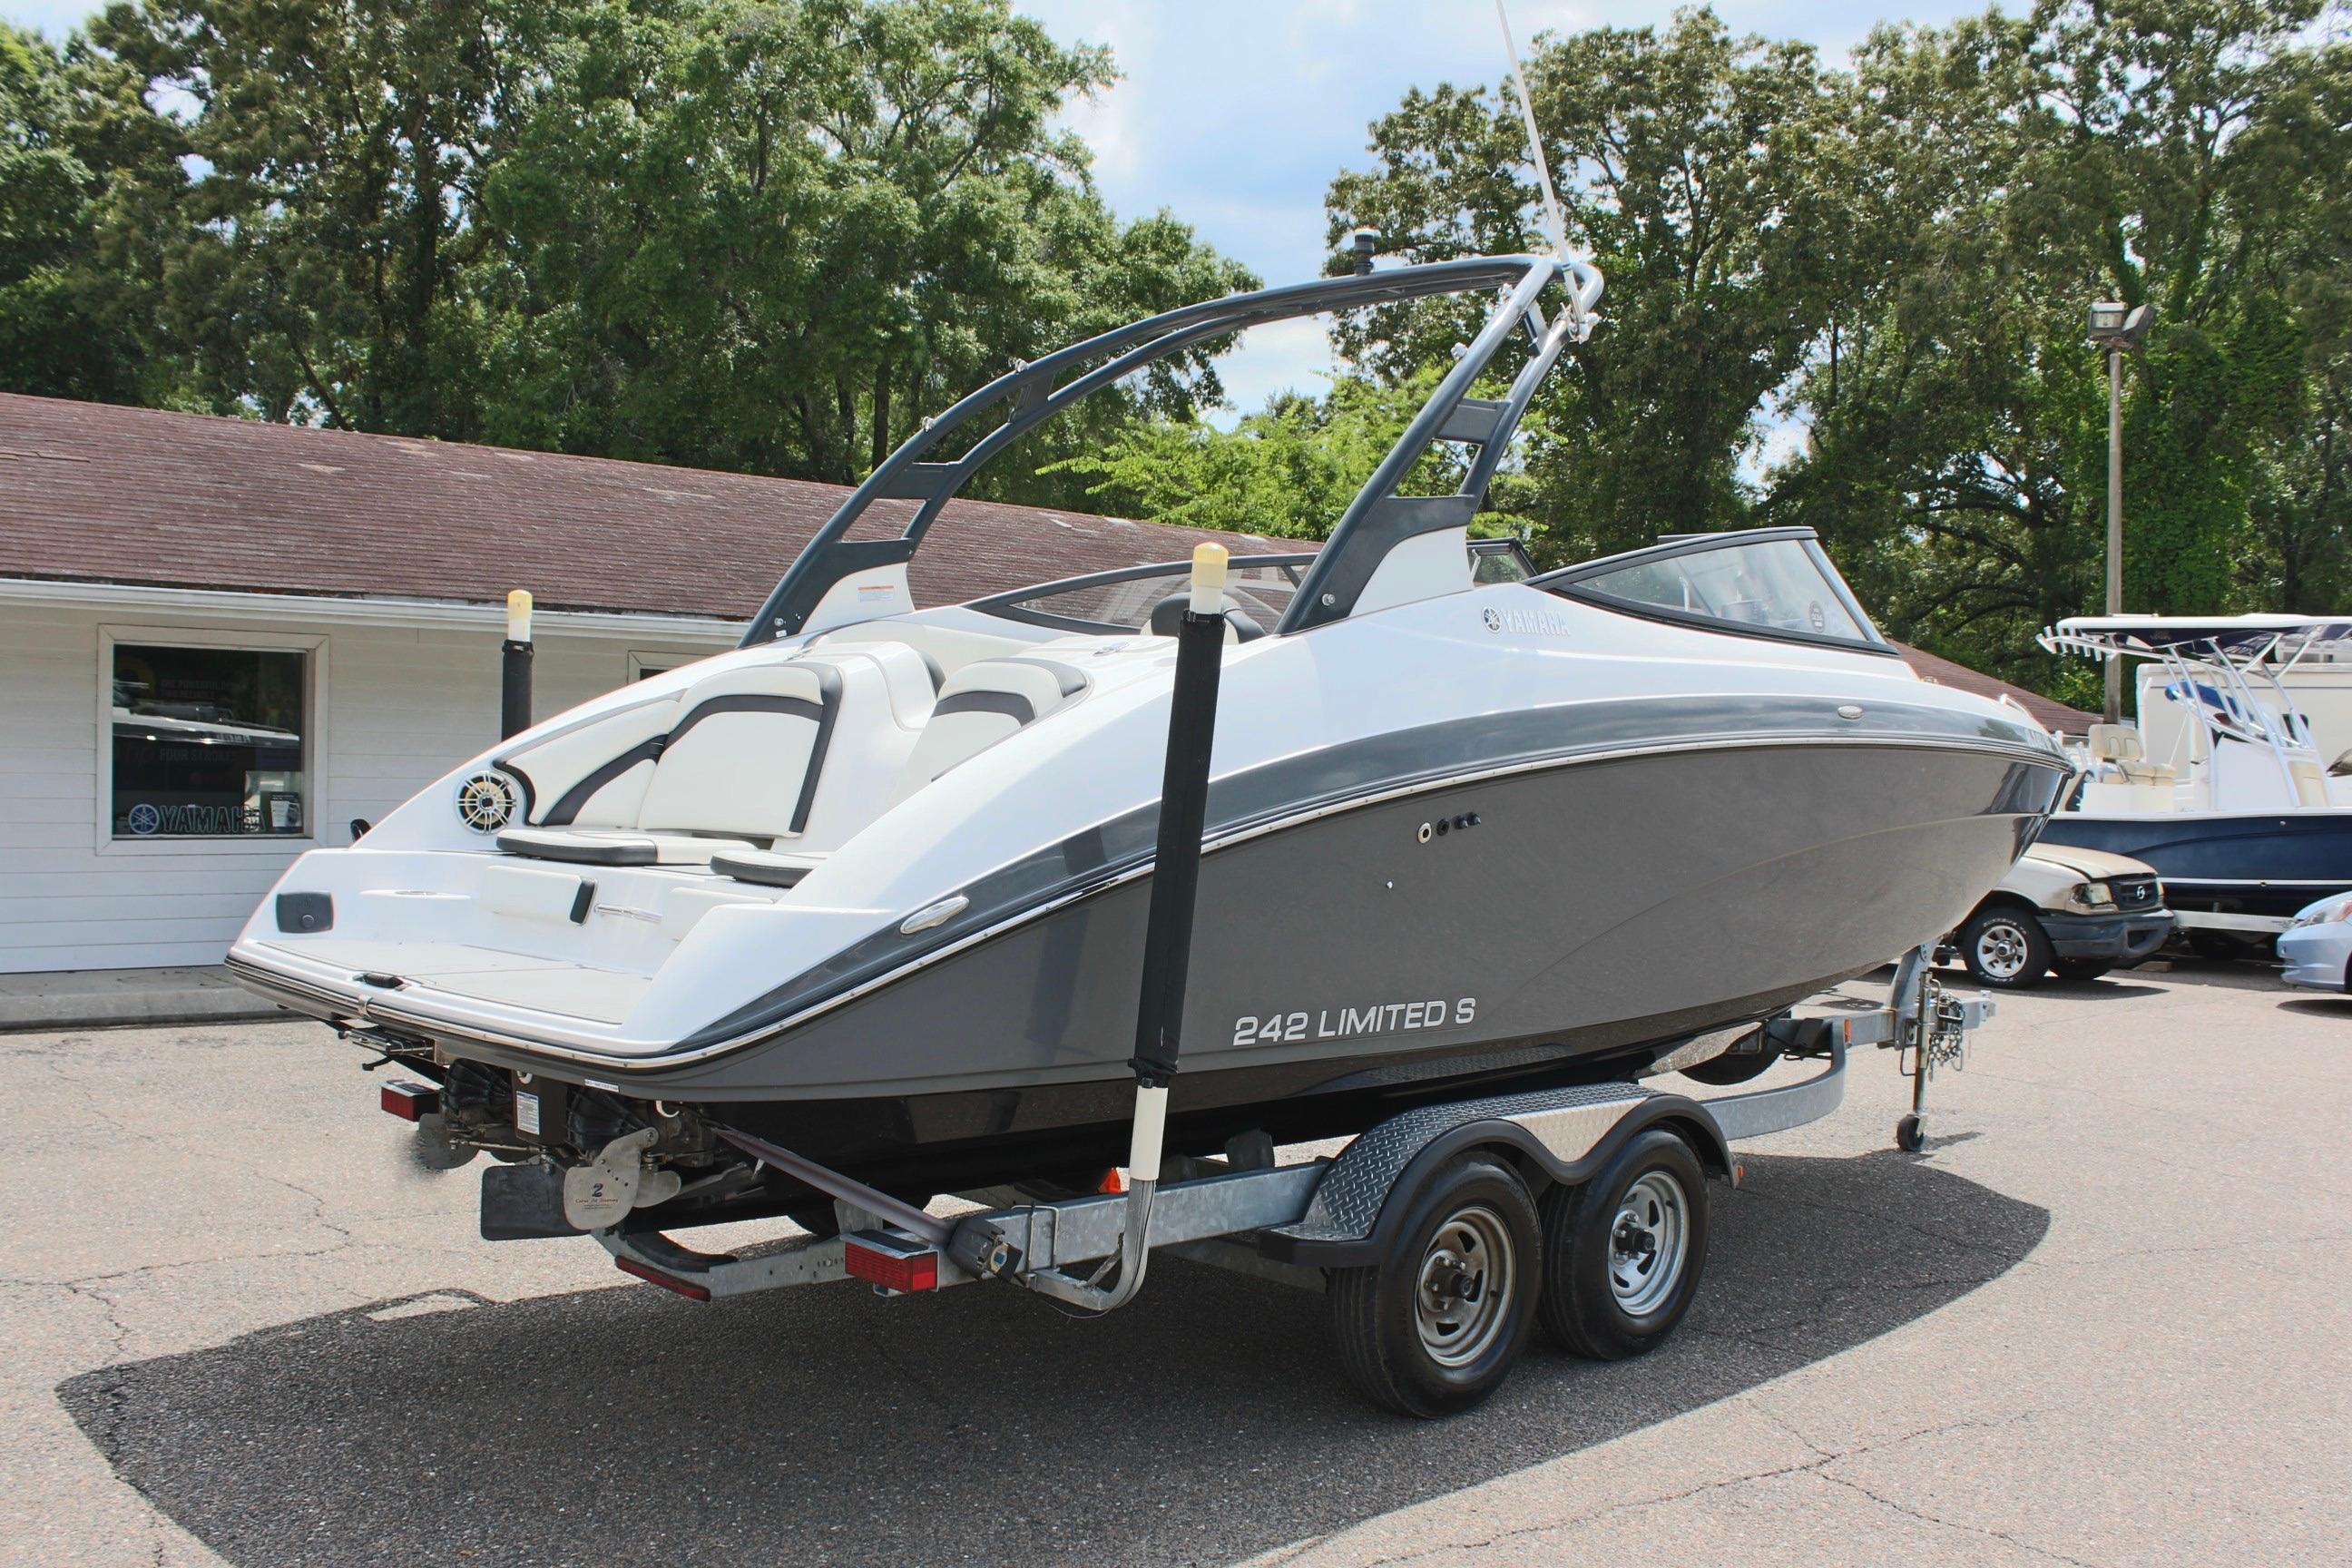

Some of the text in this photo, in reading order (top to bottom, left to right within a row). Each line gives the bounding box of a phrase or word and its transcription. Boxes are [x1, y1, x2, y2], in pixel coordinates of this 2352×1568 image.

[1501, 609, 1570, 636] YAMAHA
[161, 805, 266, 833] YAMAHA
[1233, 997, 1476, 1046] 242 LIMITED S
